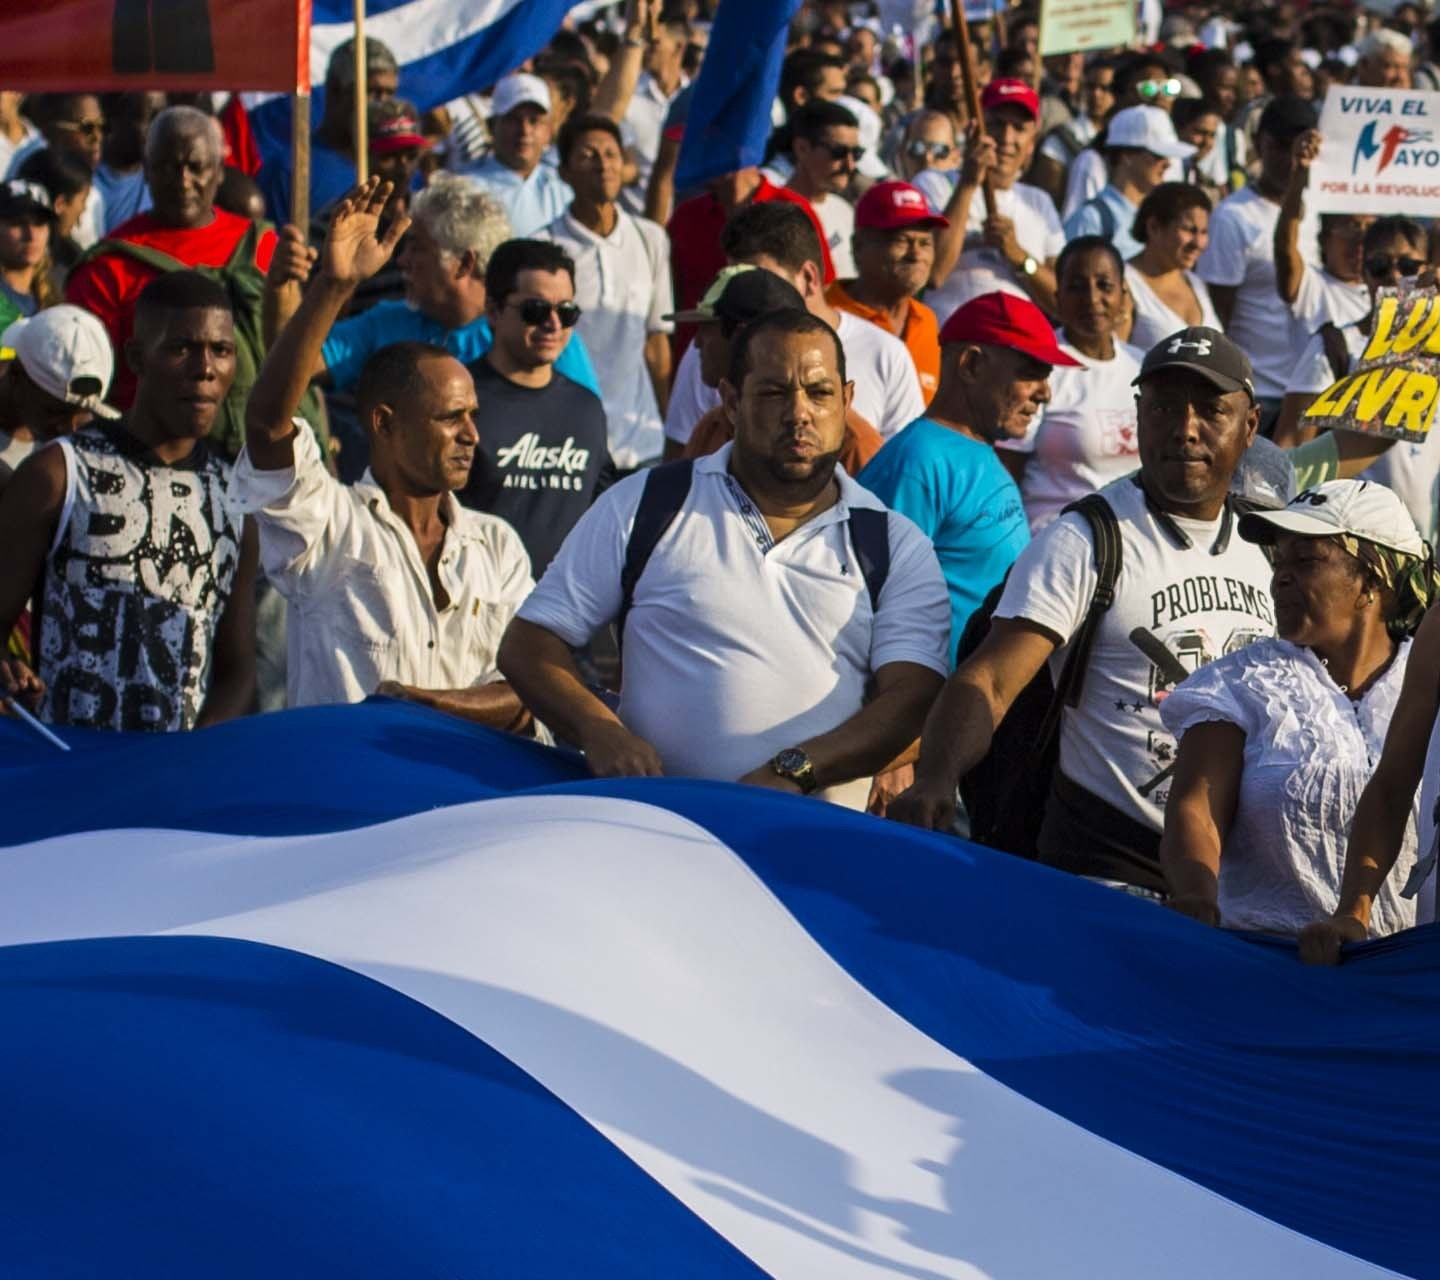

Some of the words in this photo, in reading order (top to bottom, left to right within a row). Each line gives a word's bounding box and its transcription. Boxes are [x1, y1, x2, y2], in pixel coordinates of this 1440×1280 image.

[1340, 97, 1393, 115] VIVA
[1401, 99, 1428, 116] EL
[1320, 181, 1348, 193] POR
[1354, 183, 1370, 195] LA
[1304, 366, 1439, 433] LIVR
[497, 431, 590, 475] Alaska
[503, 474, 583, 492] AIRLINES
[1151, 576, 1274, 630] PROBLEMS
